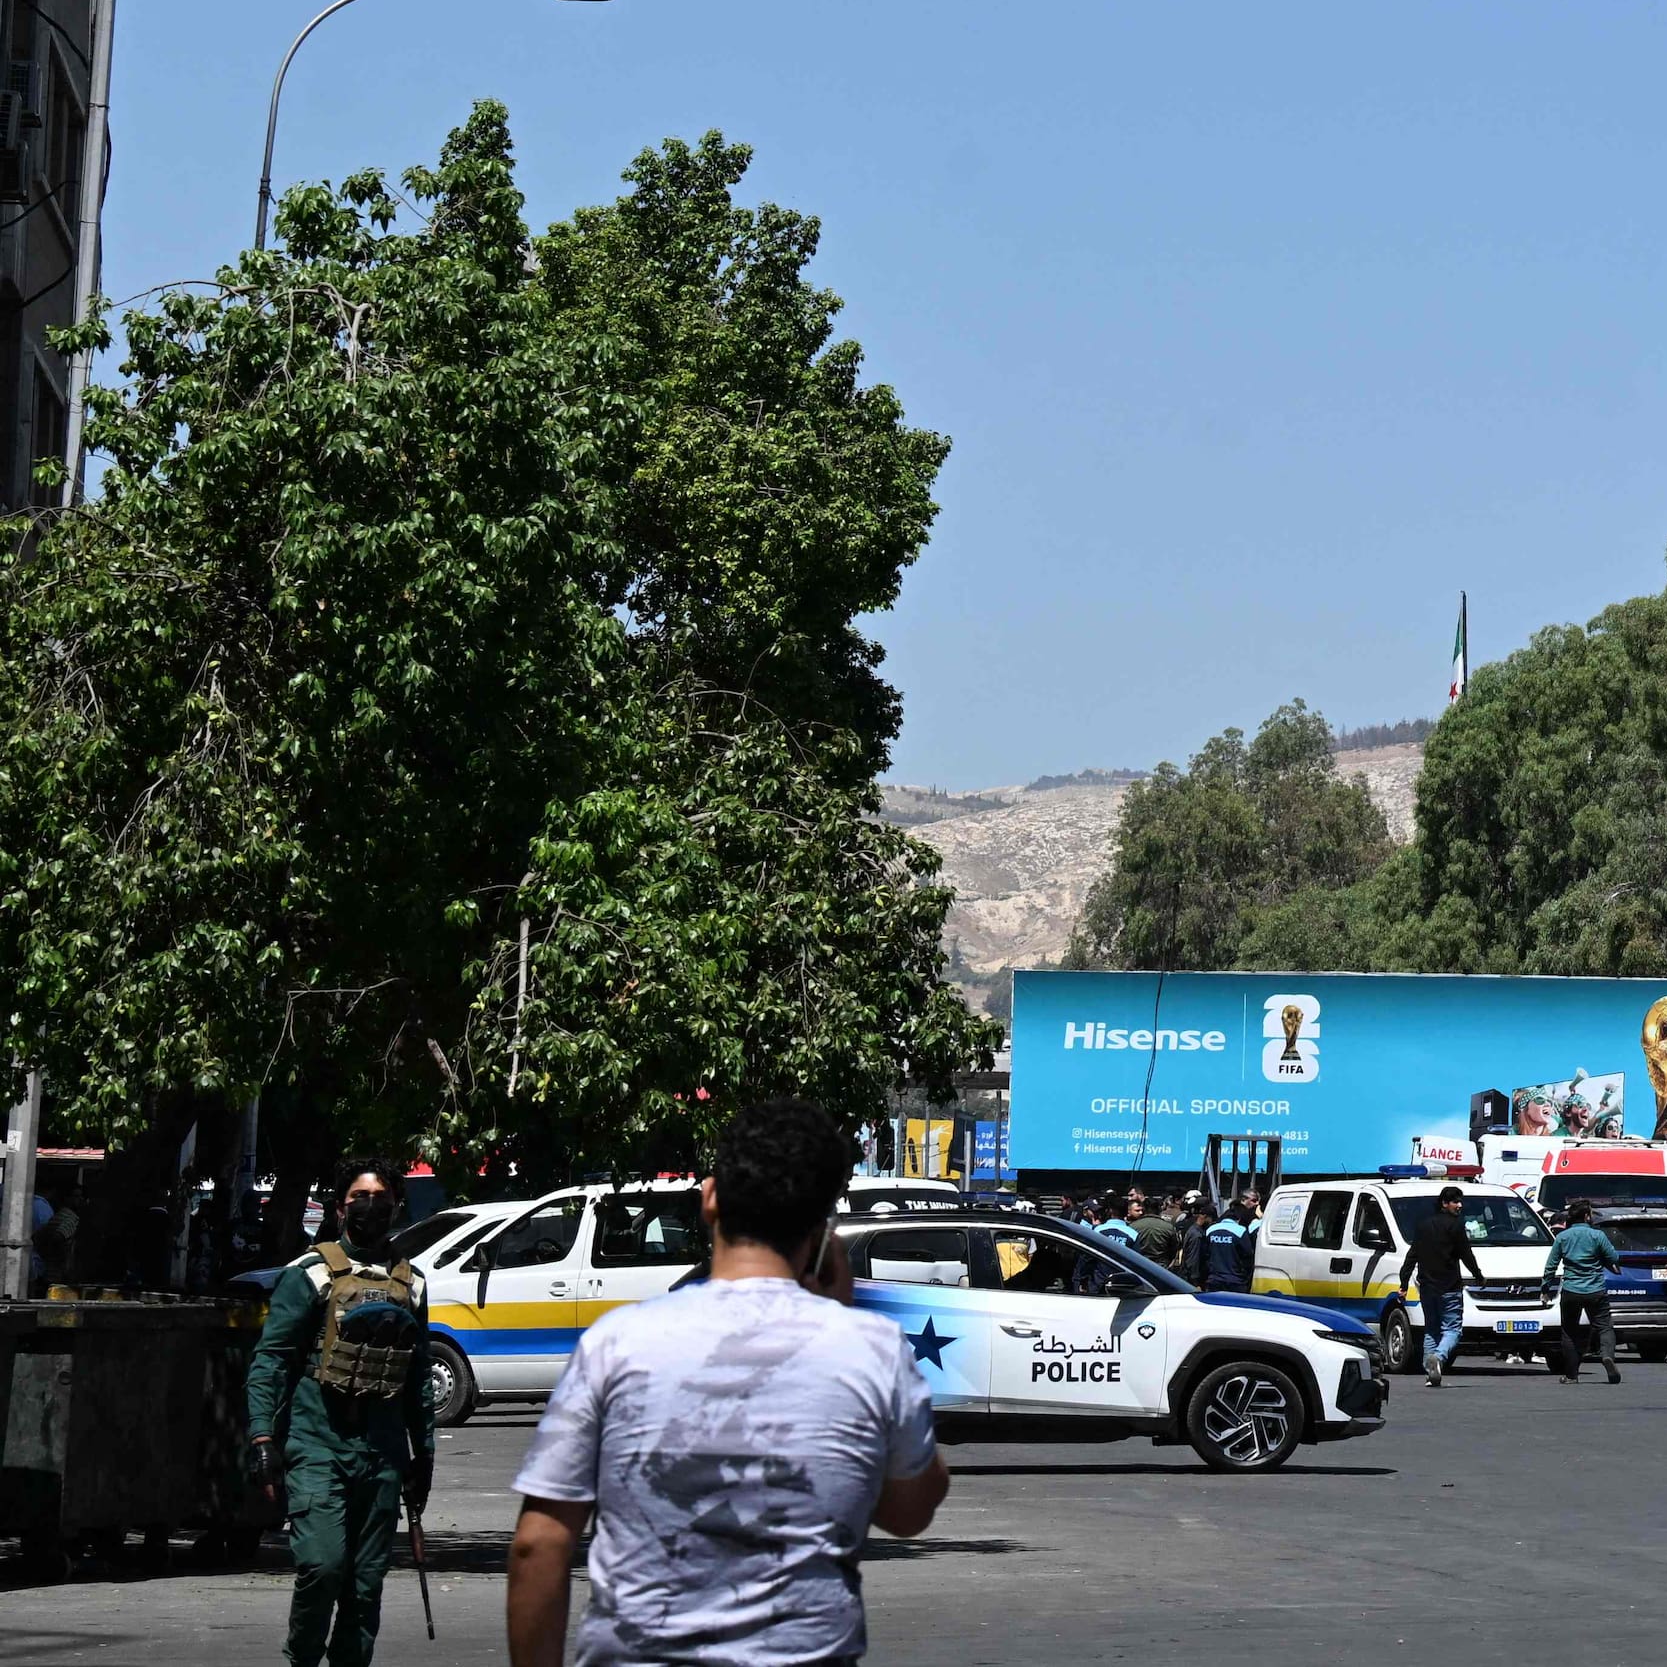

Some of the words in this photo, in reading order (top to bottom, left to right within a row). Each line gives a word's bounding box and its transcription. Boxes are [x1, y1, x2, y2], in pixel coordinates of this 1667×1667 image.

[1064, 1022, 1226, 1051] Hisense
[1278, 1065, 1304, 1074] FIFA
[1091, 1098, 1184, 1114] OFFICIAL
[1190, 1099, 1290, 1115] SPONSOR
[1083, 1143, 1123, 1154] Hisense
[1146, 1143, 1172, 1156] Syria
[1210, 1235, 1232, 1244] POLICE
[1031, 1361, 1121, 1383] POLICE
